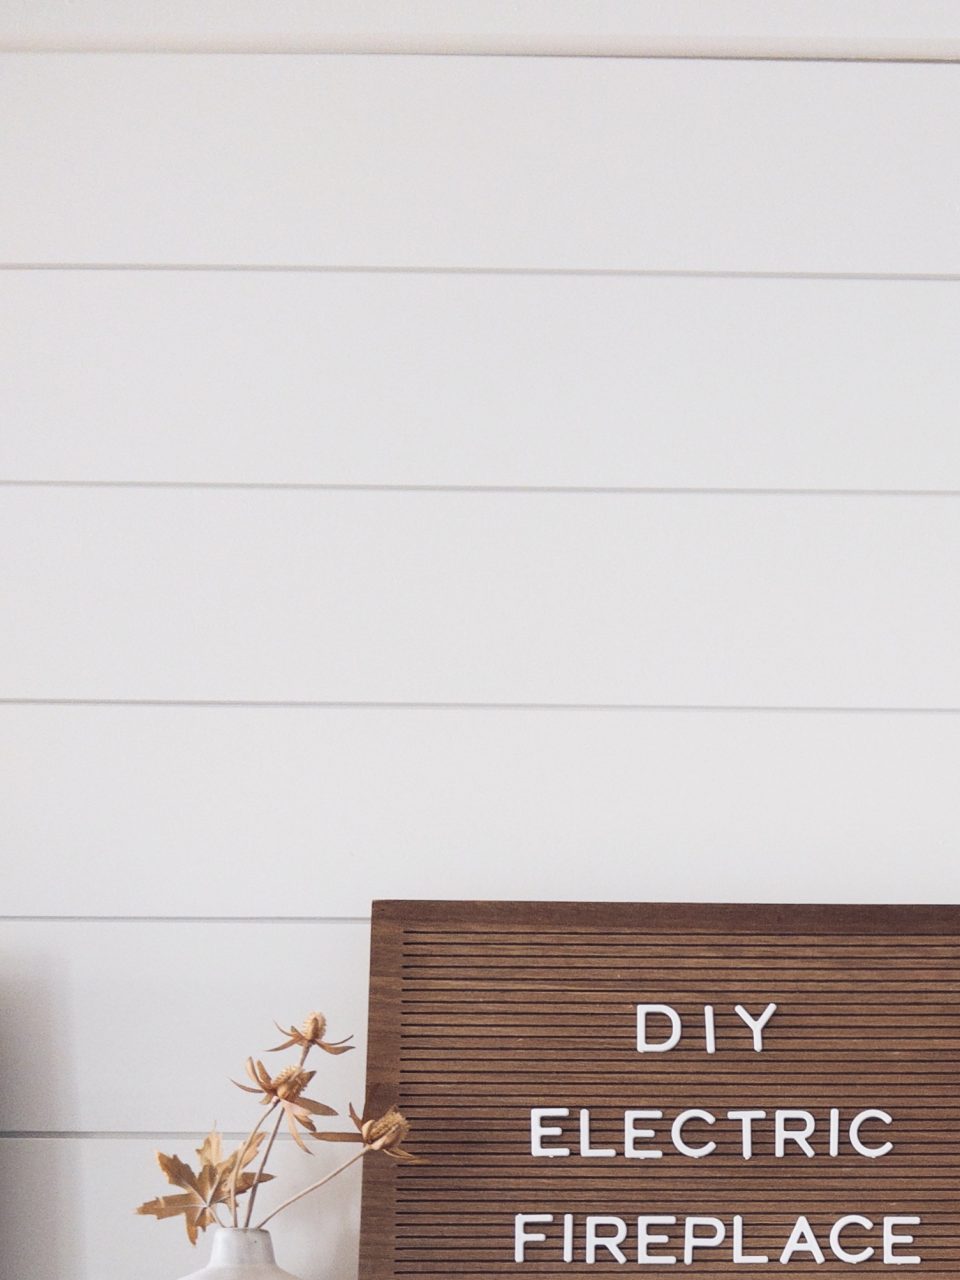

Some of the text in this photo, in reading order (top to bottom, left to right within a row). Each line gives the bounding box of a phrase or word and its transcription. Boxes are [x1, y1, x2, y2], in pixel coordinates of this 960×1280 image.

[636, 1002, 777, 1054] DIY
[529, 1106, 894, 1160] ELECTRIC
[513, 1212, 922, 1266] FIREPLACE
